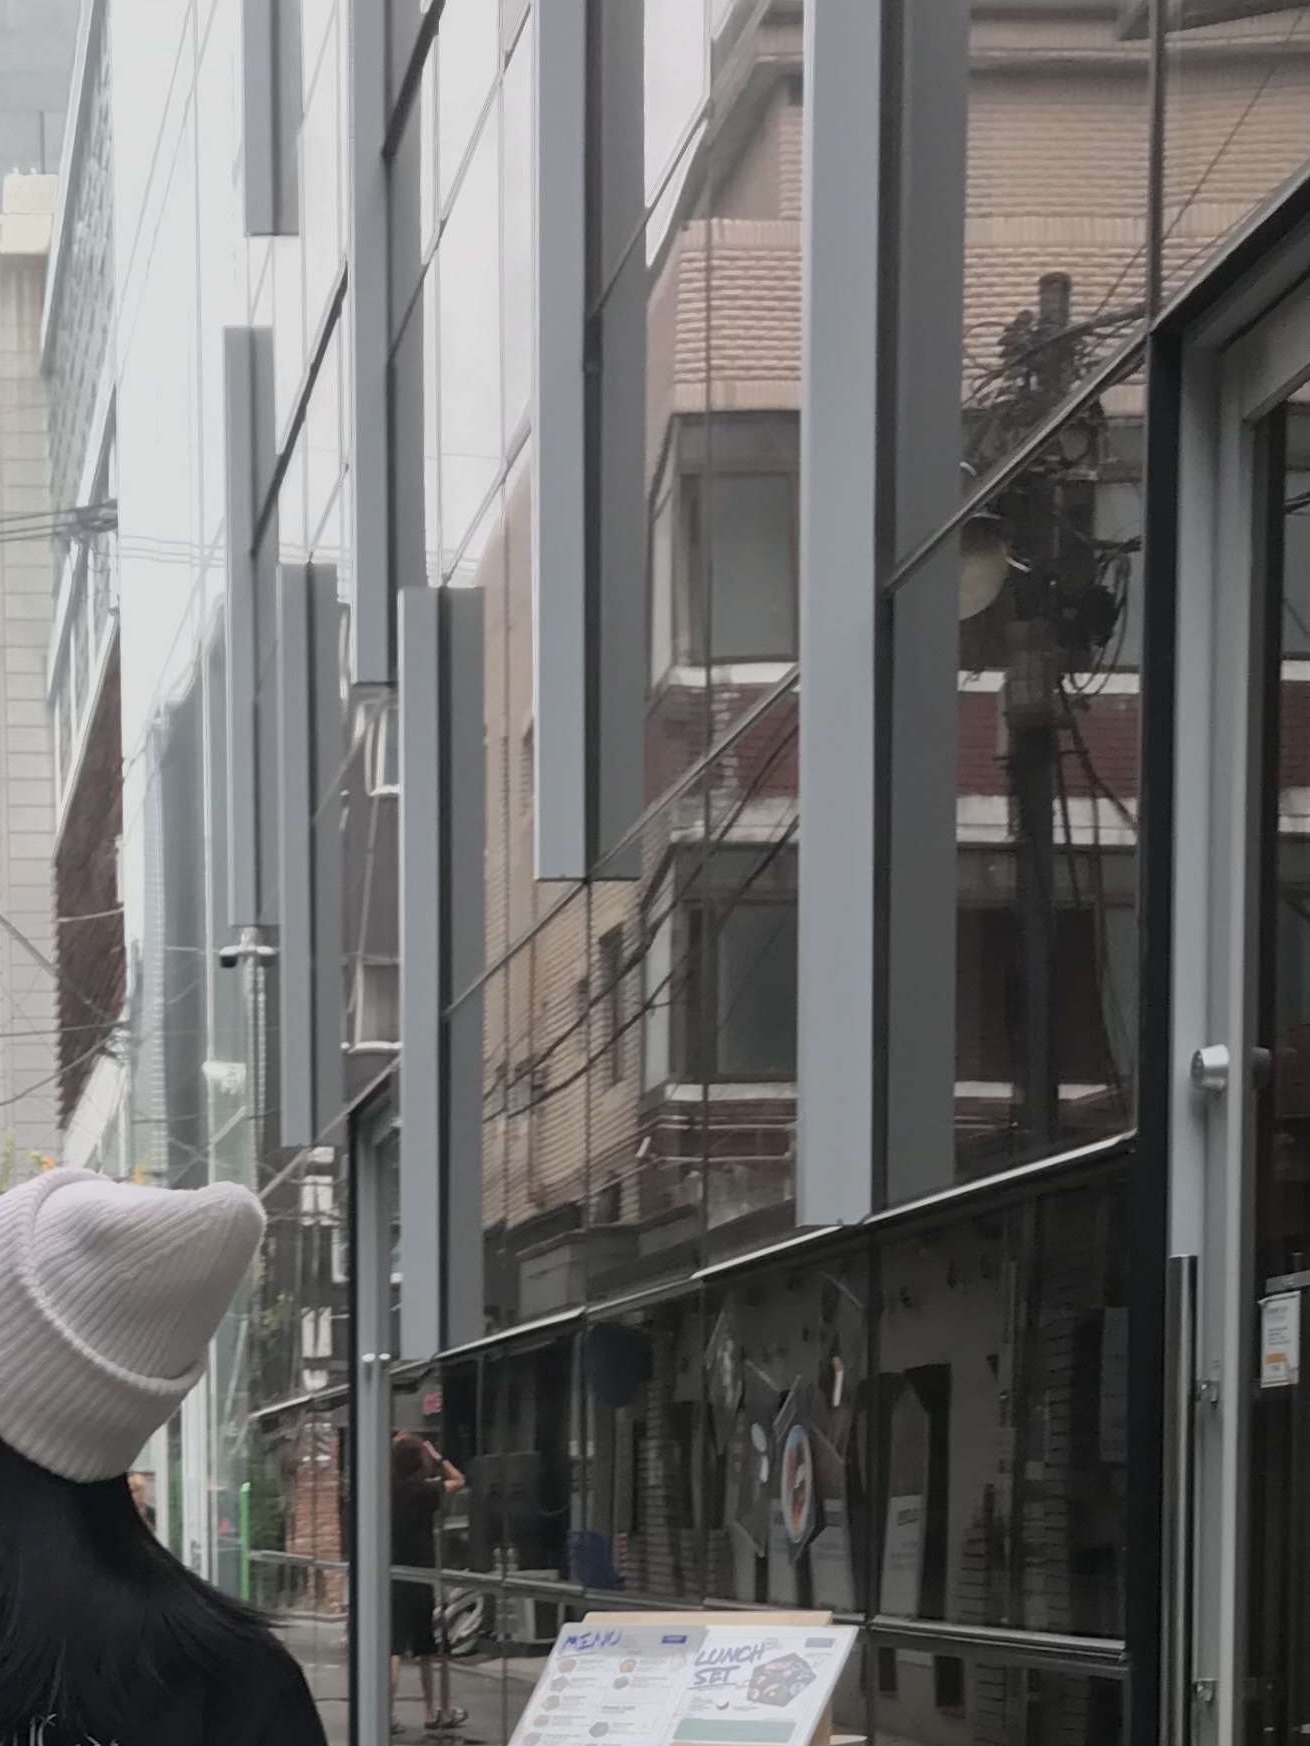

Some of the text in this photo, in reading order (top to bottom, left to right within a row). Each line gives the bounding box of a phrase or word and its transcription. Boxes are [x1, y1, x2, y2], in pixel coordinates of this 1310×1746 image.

[558, 1629, 622, 1656] MENU
[693, 1641, 767, 1667] LUNCH
[693, 1665, 741, 1686] SET
